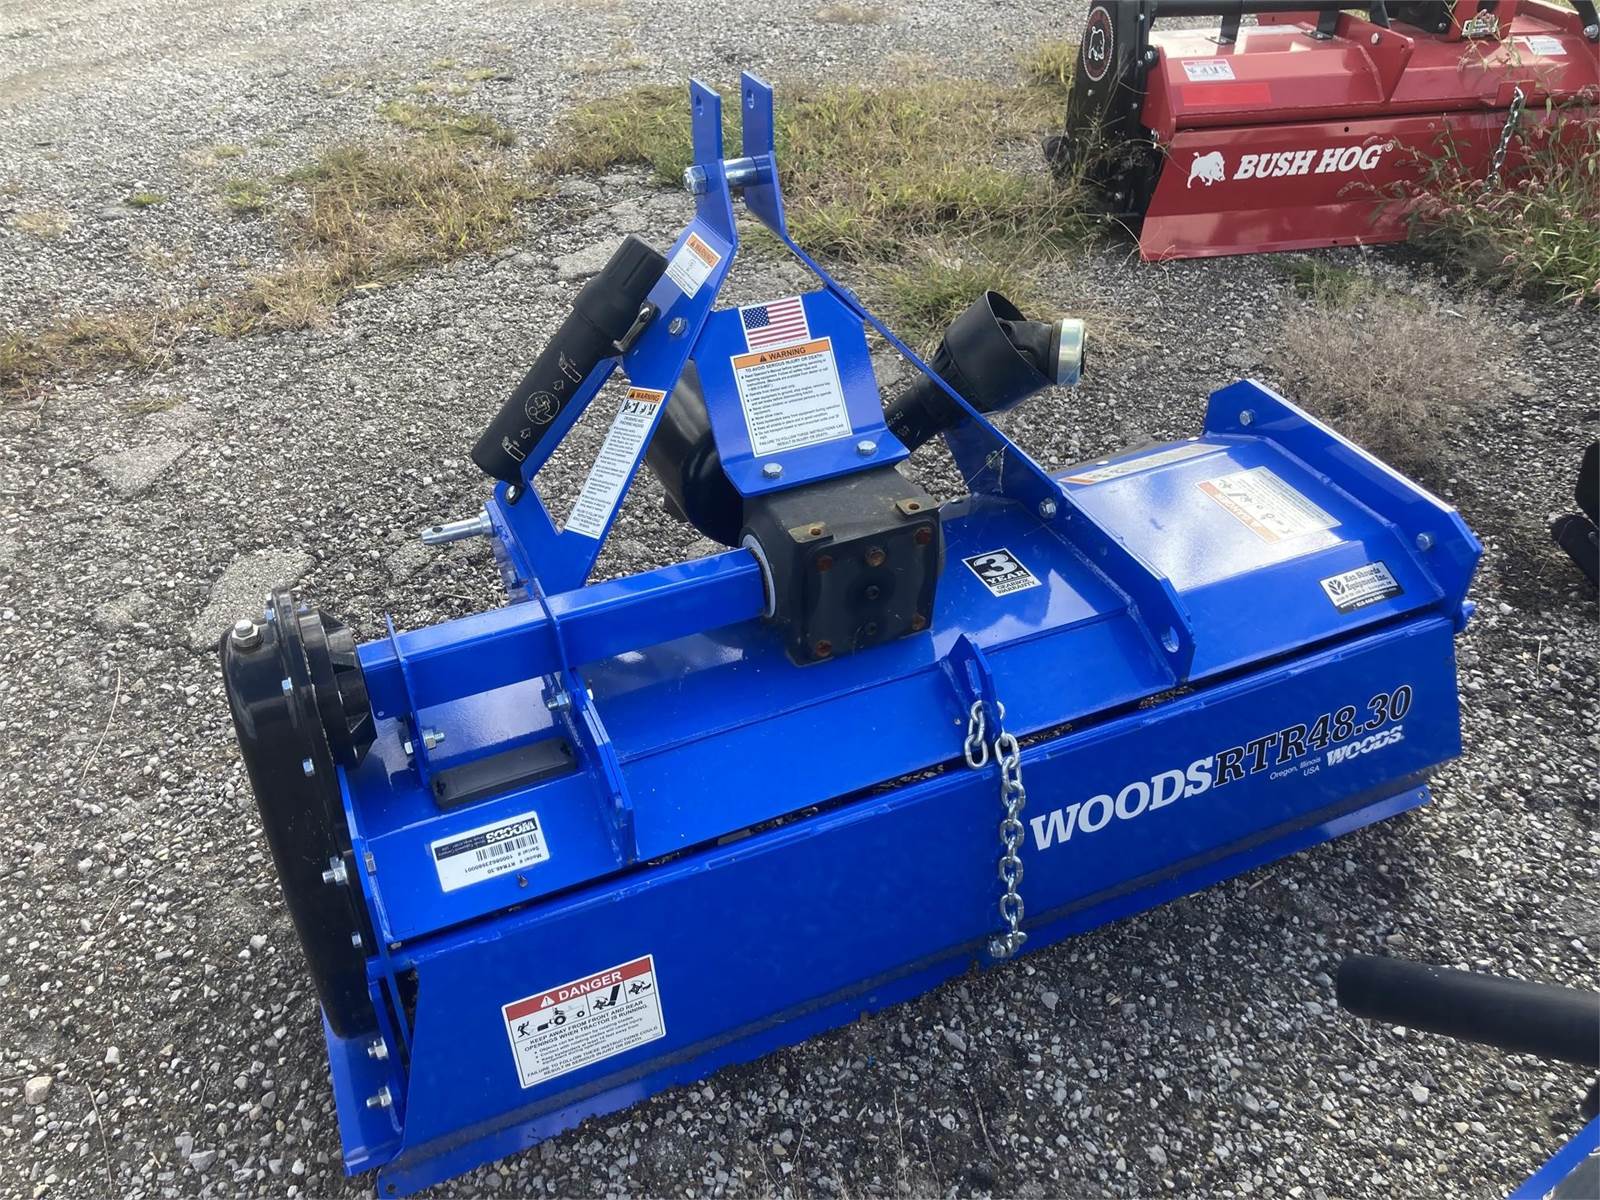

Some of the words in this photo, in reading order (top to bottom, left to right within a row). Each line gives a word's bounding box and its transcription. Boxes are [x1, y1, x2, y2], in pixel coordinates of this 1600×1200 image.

[1233, 150, 1317, 180] BUSH
[1315, 144, 1383, 174] HOG
[768, 346, 806, 360] WARNING
[974, 553, 1018, 577] 3
[986, 571, 1027, 583] YEAR
[1326, 724, 1405, 767] WOODS
[1030, 756, 1214, 851] WOODS
[1212, 685, 1413, 788] RTR48.30
[1269, 765, 1298, 781] Oregon,
[1303, 764, 1320, 777] USA
[486, 821, 535, 843] WOODS
[558, 971, 623, 1001] DANGER
[524, 1036, 557, 1052] OPENINGS
[559, 1028, 578, 1039] WHEN
[580, 1017, 609, 1031] TRACTOR
[529, 1034, 547, 1044] KEEP
[548, 1027, 566, 1038] AWAY
[567, 1020, 587, 1031] FROM
[587, 1012, 609, 1023] FRONT
[610, 1006, 624, 1015] AND
[625, 999, 642, 1009] REAR
